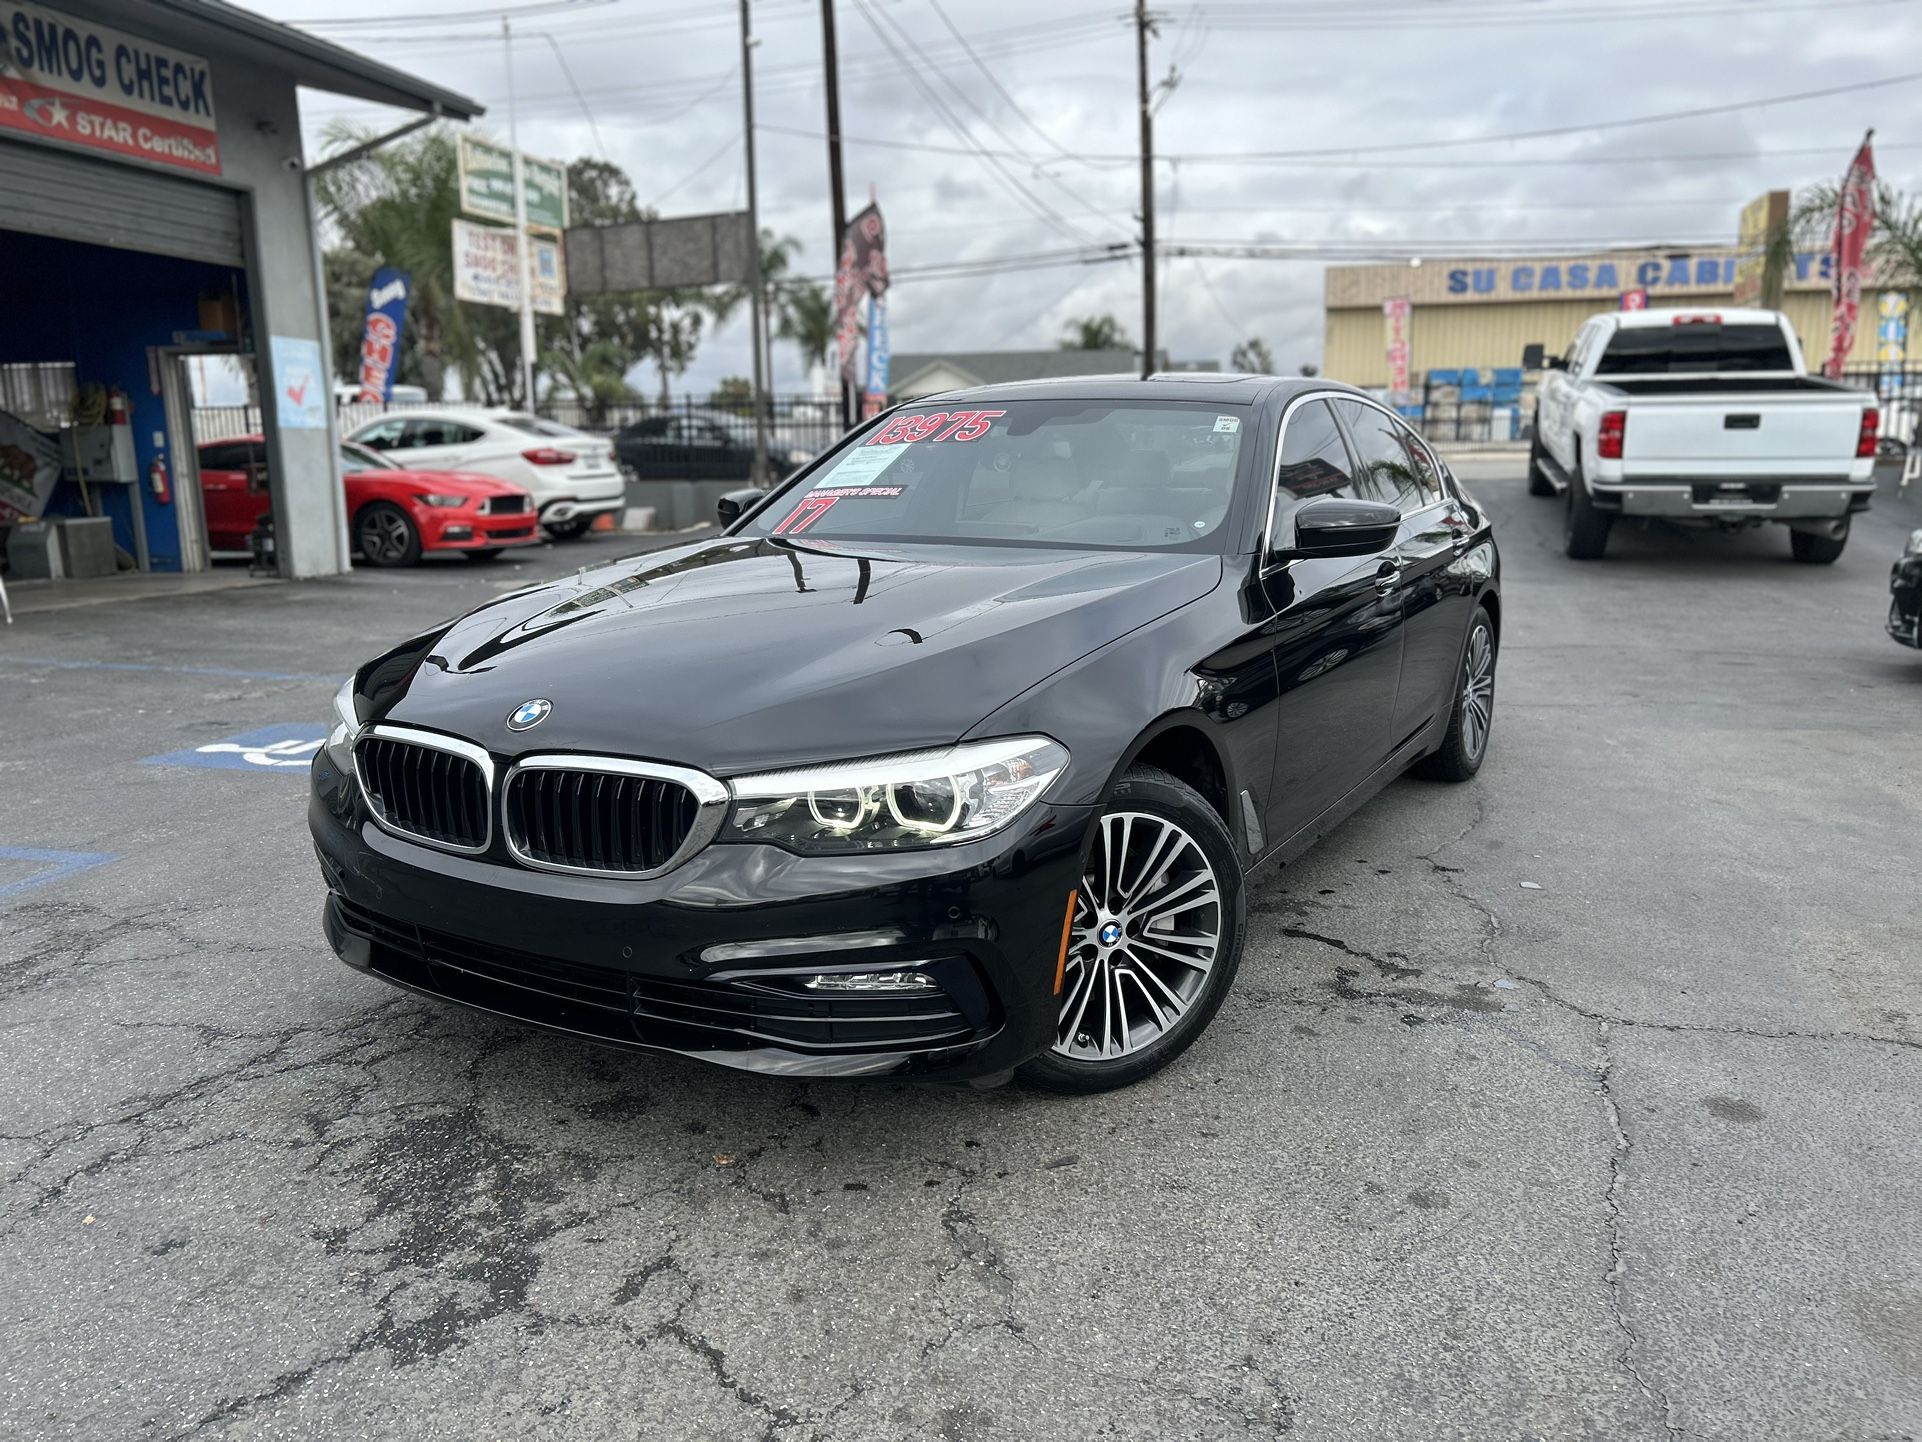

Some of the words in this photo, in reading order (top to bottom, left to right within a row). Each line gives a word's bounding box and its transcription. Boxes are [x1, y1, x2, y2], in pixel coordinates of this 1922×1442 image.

[12, 12, 106, 88] SMOG
[115, 44, 212, 117] CHECK
[76, 112, 134, 146] STAR
[1448, 268, 1497, 294] SU
[1511, 263, 1619, 292] CASA
[1637, 252, 1833, 286] CABITS
[866, 410, 1008, 446] 13975
[772, 496, 841, 535] 17
